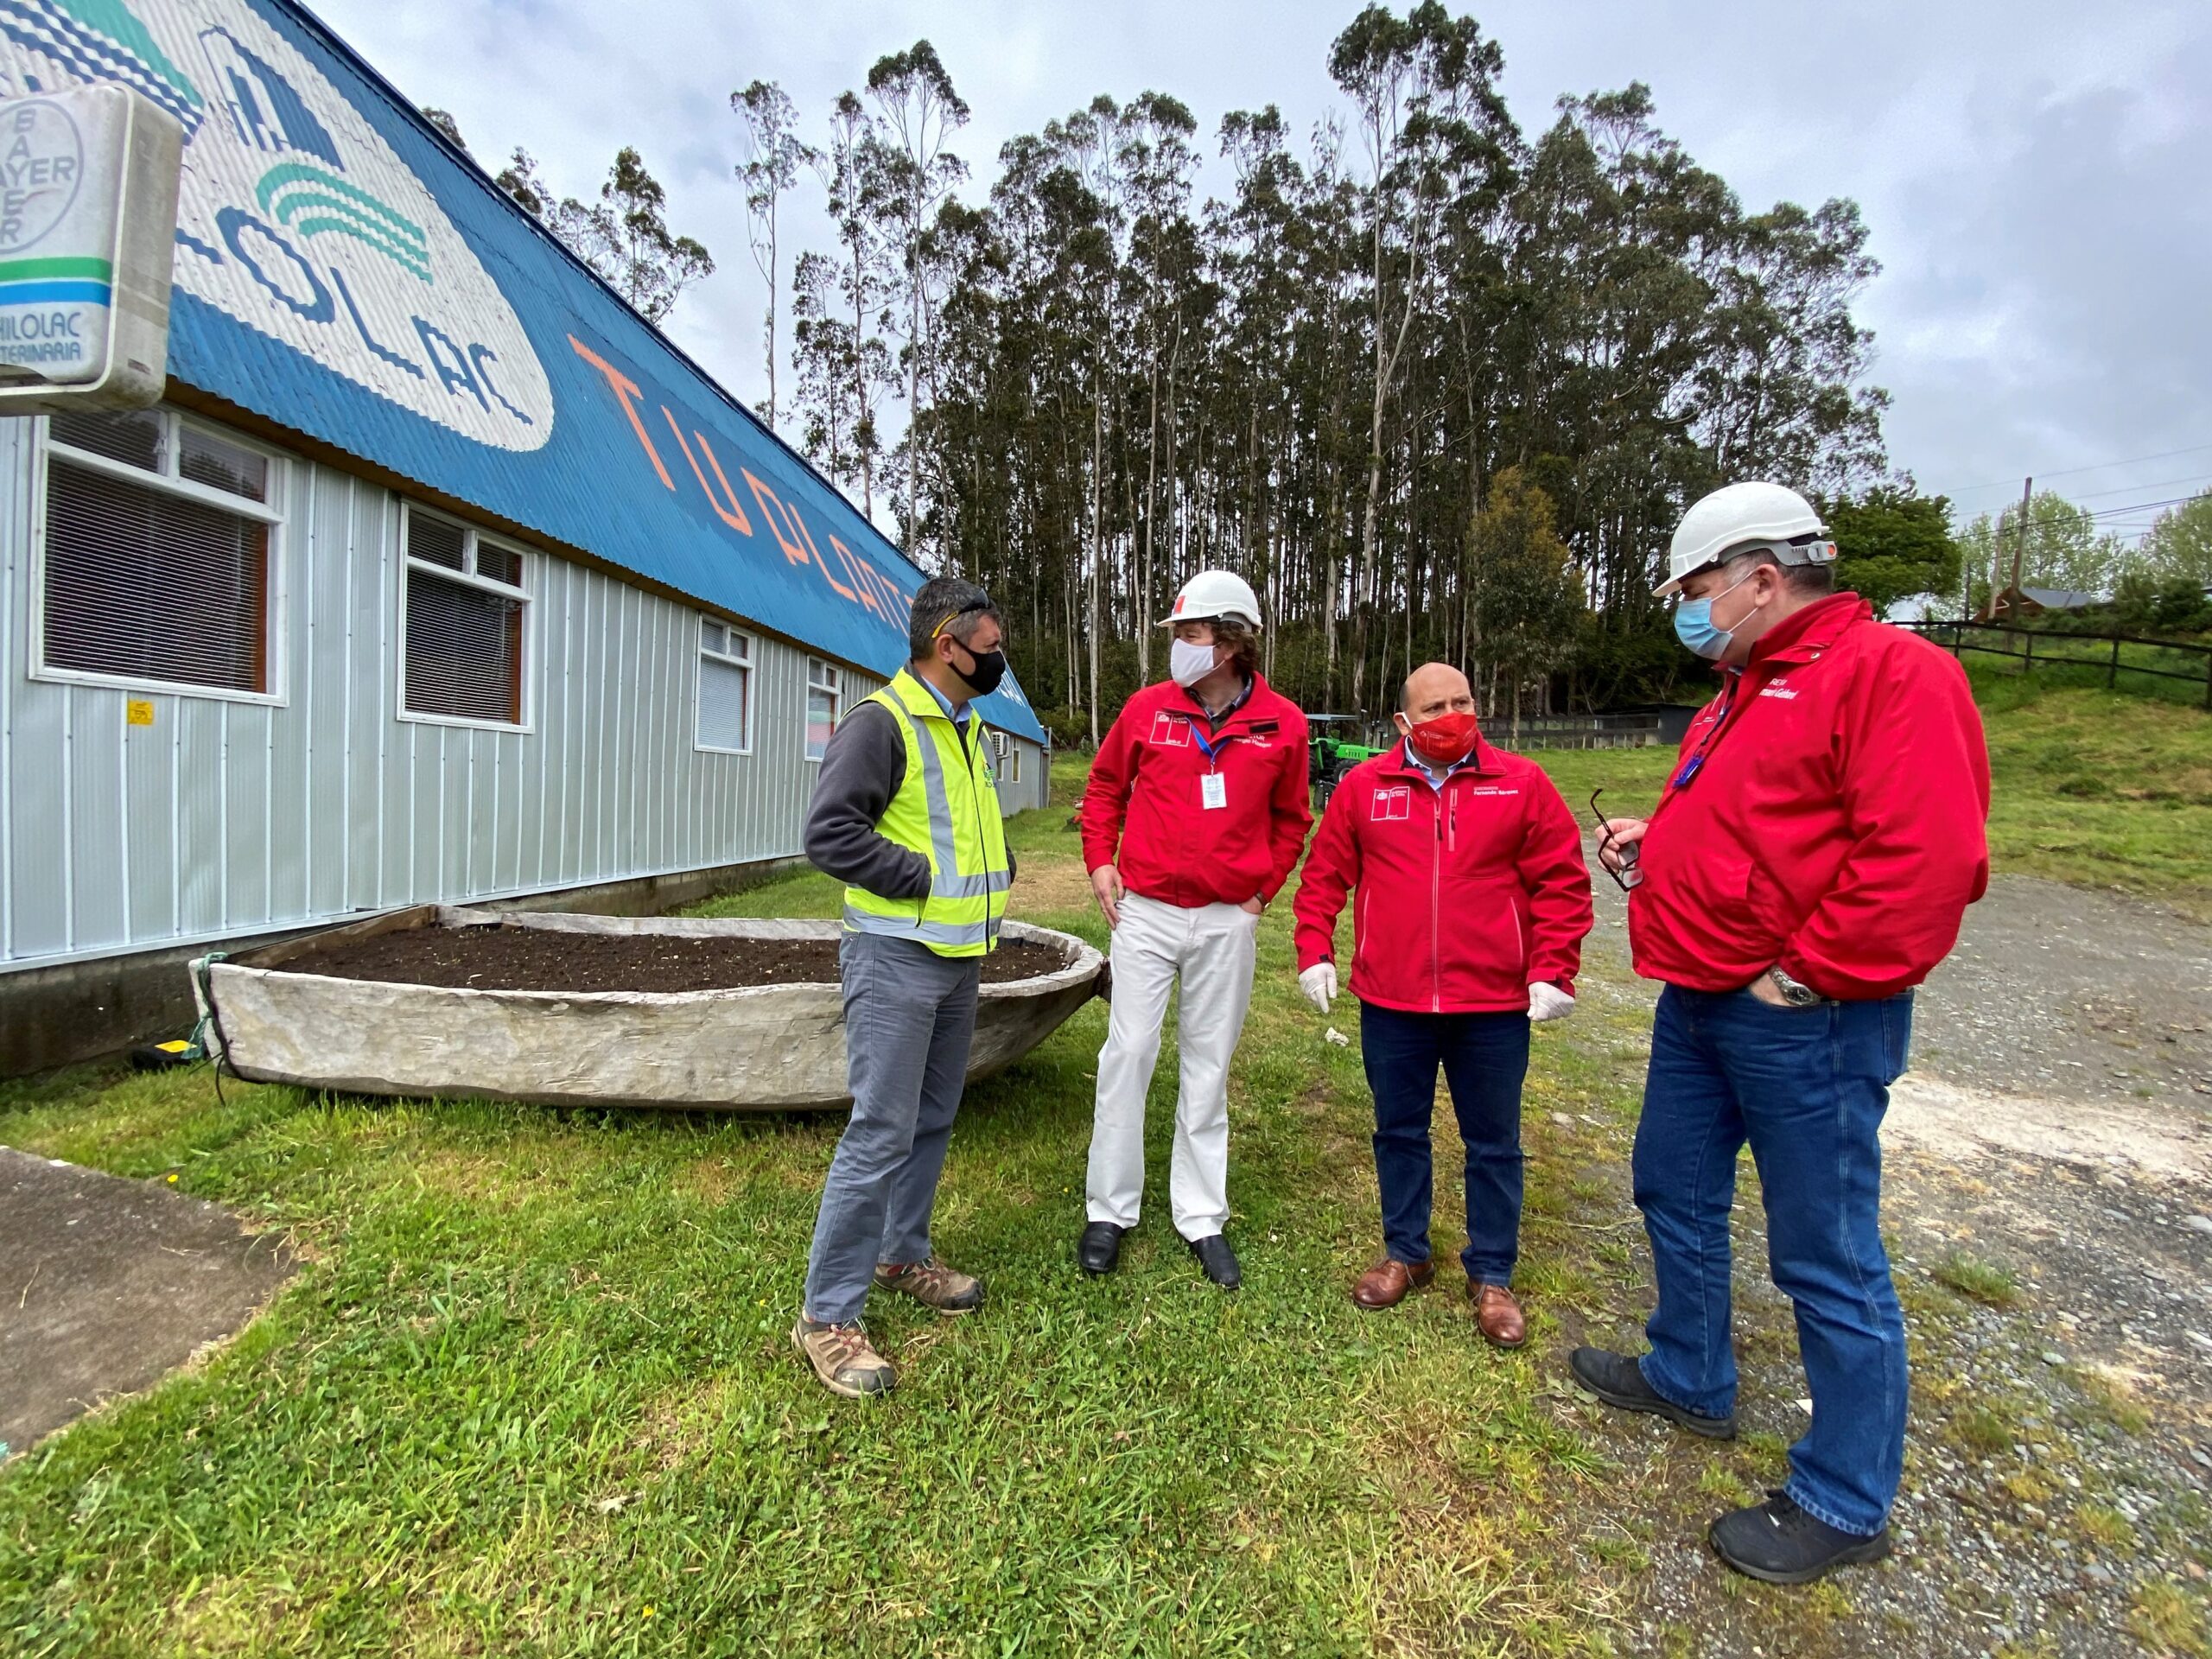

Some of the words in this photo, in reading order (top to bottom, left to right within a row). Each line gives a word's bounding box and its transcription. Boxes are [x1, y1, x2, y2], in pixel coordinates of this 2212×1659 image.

[0, 156, 75, 188] YER
[0, 108, 35, 244] BAYER
[567, 333, 753, 537] TU
[741, 467, 915, 639] PLANT
